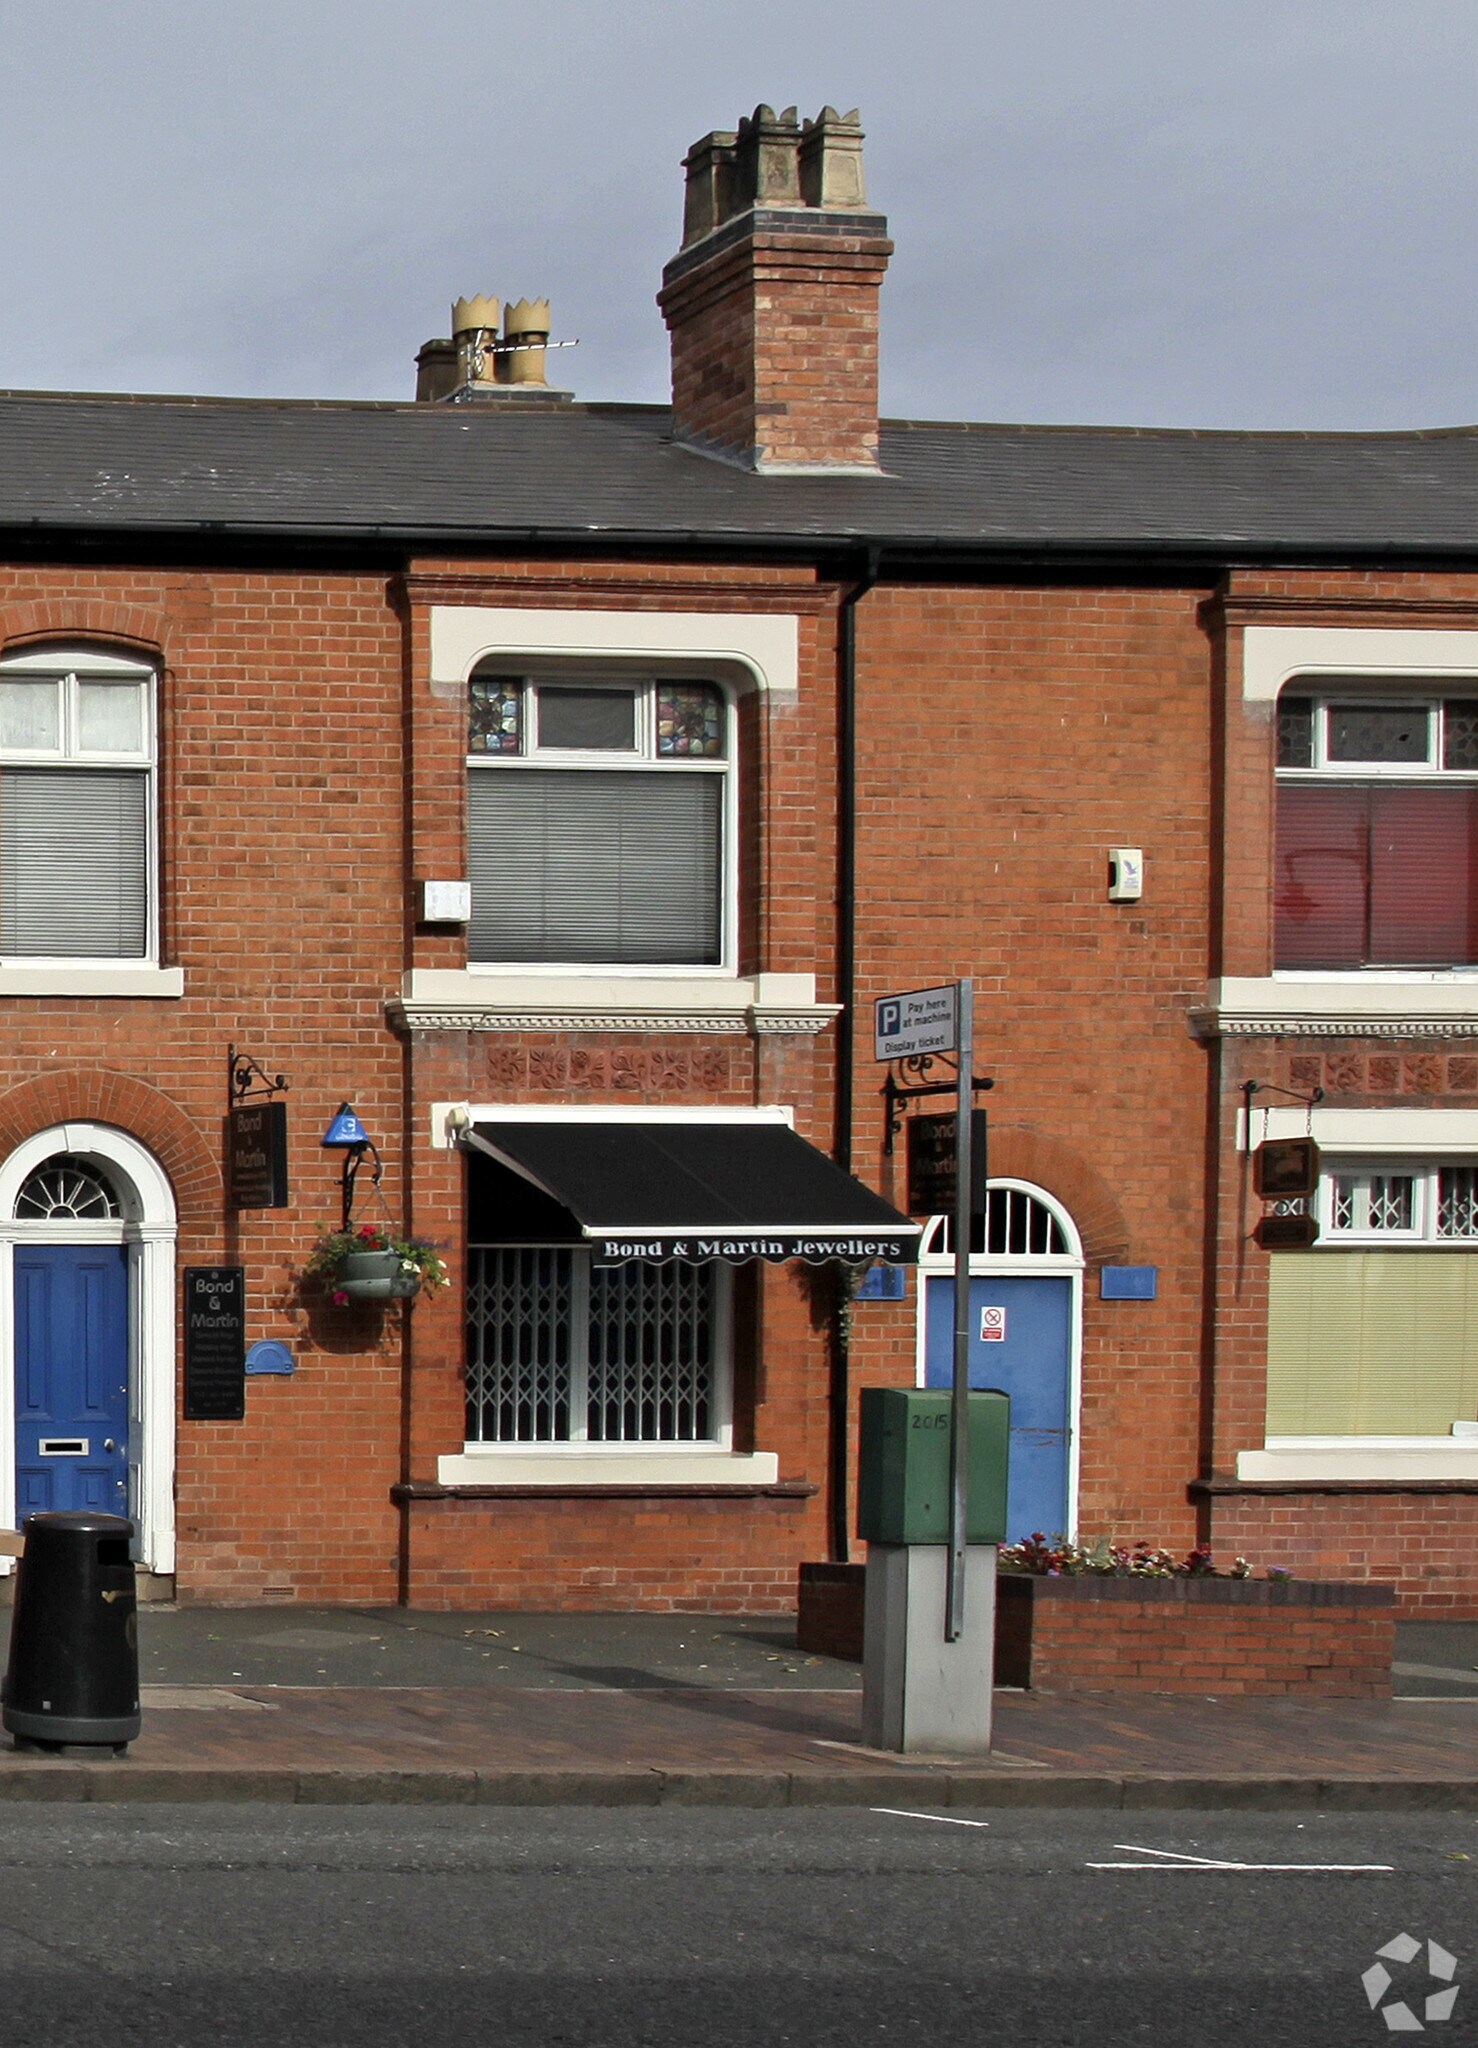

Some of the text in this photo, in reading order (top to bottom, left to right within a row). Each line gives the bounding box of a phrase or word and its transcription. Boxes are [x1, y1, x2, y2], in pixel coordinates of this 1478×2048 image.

[907, 998, 947, 1013] Pay here
[883, 1005, 898, 1033] P
[902, 1012, 952, 1029] at machine
[885, 1035, 946, 1054] Display ticket
[237, 1111, 262, 1133] Bond
[235, 1147, 267, 1168] Martin
[604, 1239, 901, 1257] Bond & Martin Jewellers
[195, 1278, 235, 1293] Bond
[208, 1295, 222, 1311] &
[190, 1312, 239, 1328] Martin
[912, 1415, 948, 1429] 2015
